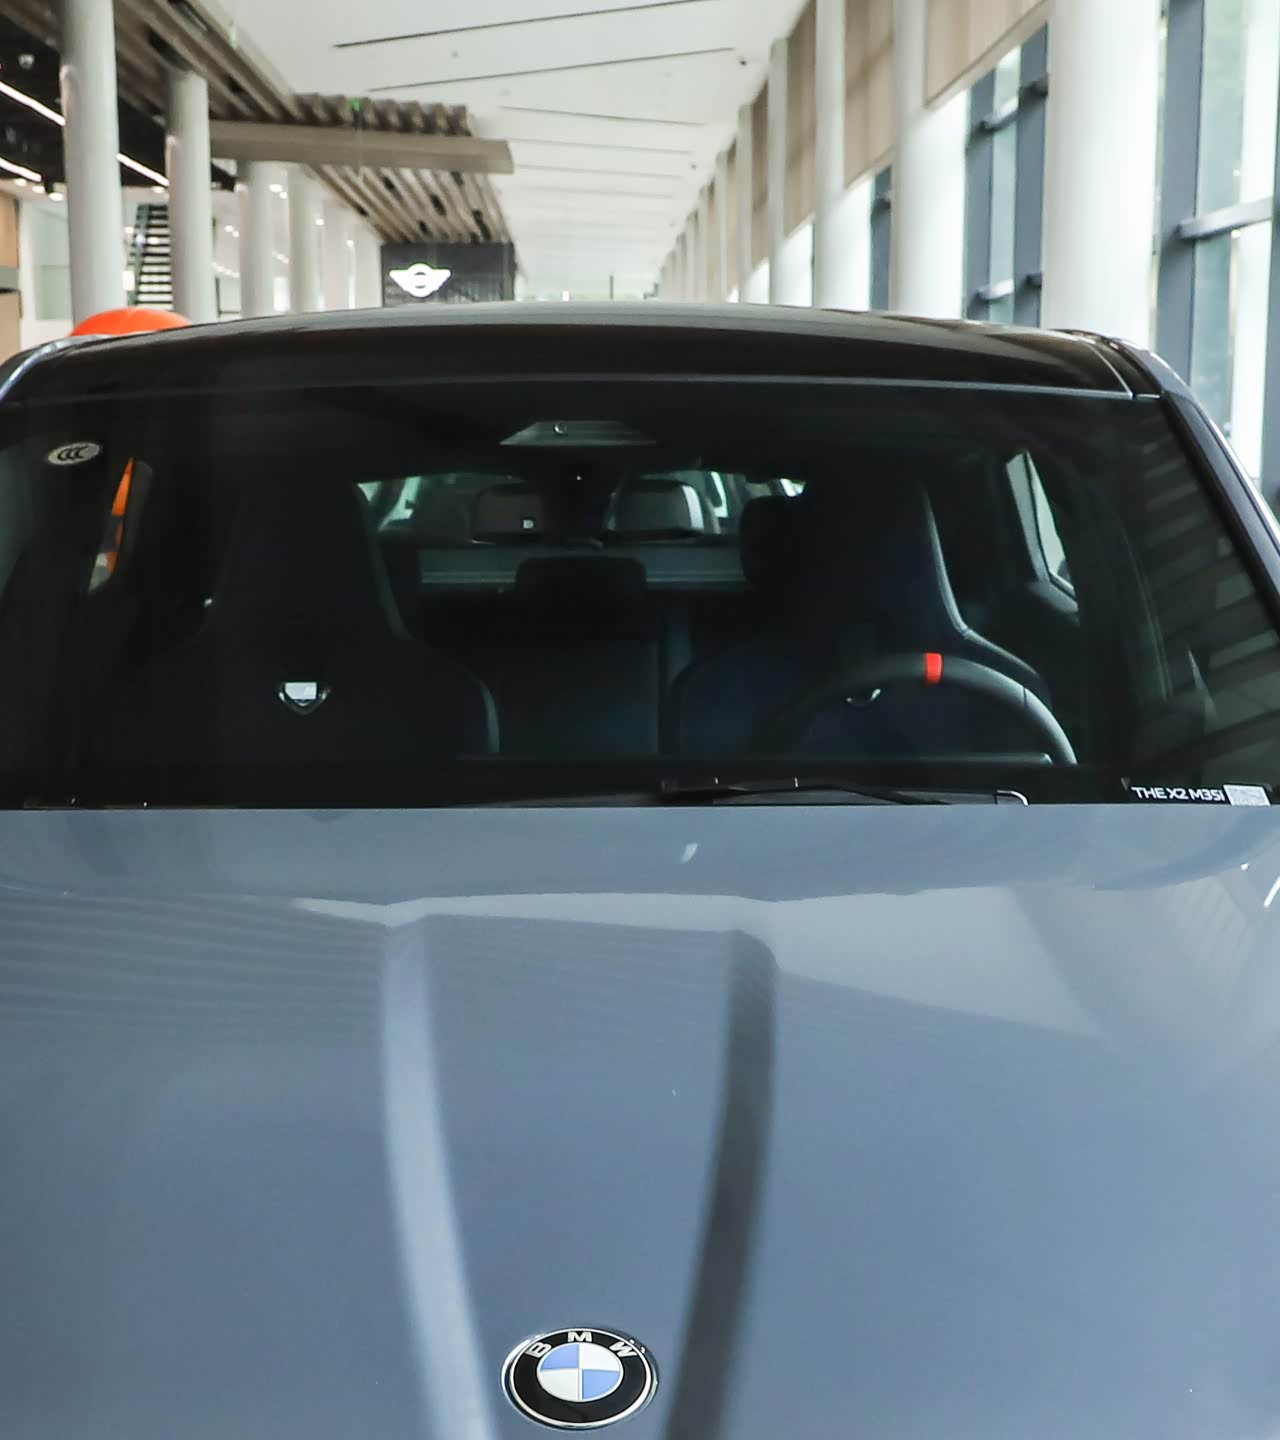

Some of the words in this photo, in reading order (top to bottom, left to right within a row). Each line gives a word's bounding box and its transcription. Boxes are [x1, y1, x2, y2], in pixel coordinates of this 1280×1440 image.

[1131, 787, 1167, 799] THE
[1166, 787, 1189, 800] X2
[525, 1331, 638, 1358] BMW
